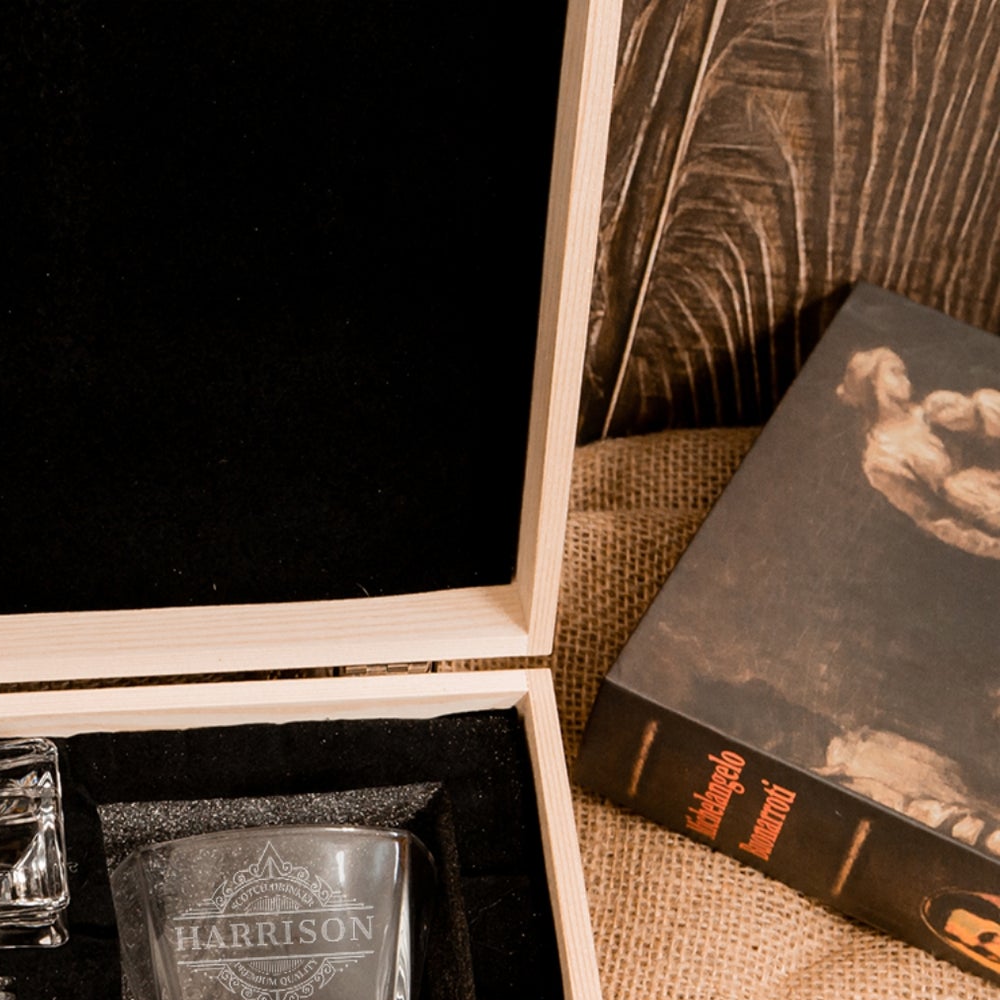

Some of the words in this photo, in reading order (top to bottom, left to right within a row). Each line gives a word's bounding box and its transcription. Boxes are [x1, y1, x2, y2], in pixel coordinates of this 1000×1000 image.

[685, 750, 746, 840] Michelangelo
[739, 778, 797, 862] Buonarroti
[231, 883, 266, 910] SCOTCH
[269, 881, 315, 907] DRINKER
[174, 915, 375, 951] HARRISON
[234, 961, 278, 986] PREMIUM
[280, 959, 319, 985] QUALITY
